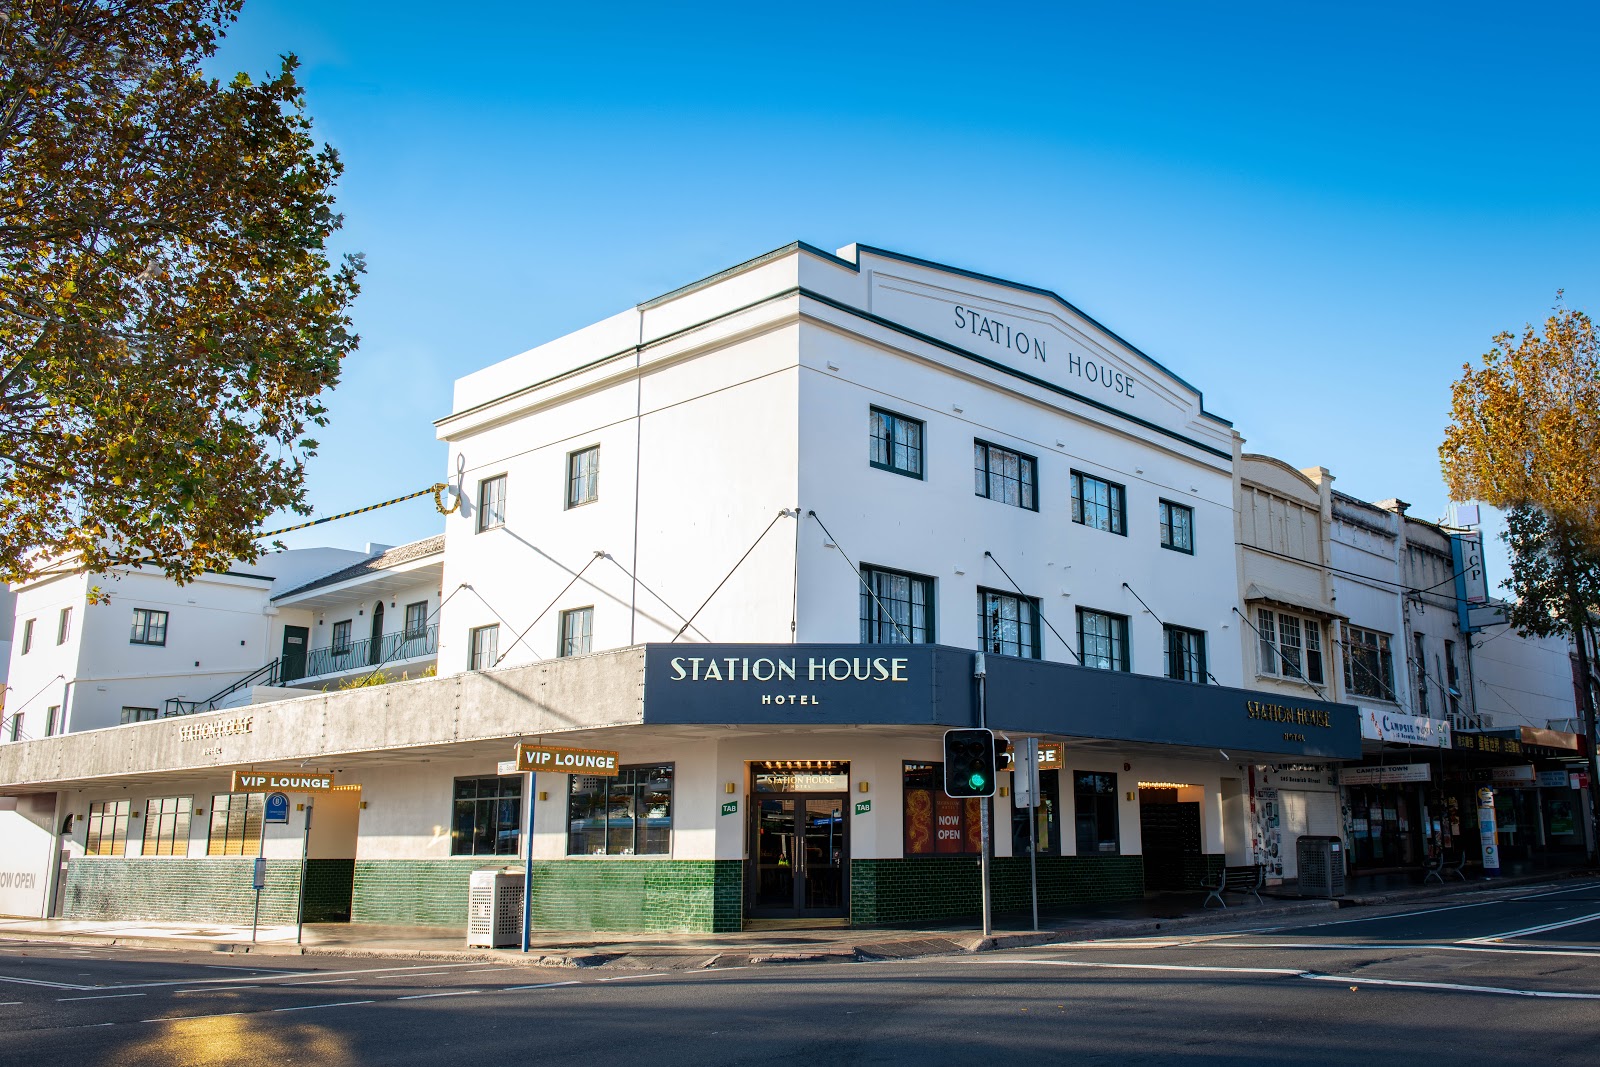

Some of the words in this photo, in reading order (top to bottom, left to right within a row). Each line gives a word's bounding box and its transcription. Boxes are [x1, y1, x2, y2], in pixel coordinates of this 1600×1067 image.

[954, 305, 1046, 363] STATION
[1068, 352, 1135, 399] HOUSE
[670, 657, 796, 681] STATION
[808, 657, 908, 682] HOUSE
[761, 694, 819, 705] HOTEL
[1246, 700, 1294, 723] STATION
[1296, 707, 1332, 728] HOUSE
[178, 722, 216, 742] STATION
[216, 716, 253, 738] HOUSE
[1283, 732, 1306, 742] HOTEL
[526, 751, 551, 765] VIP
[555, 753, 615, 769] LOUNGE
[241, 776, 266, 787] VIP
[270, 777, 330, 789] LOUNGE
[767, 776, 804, 784] STATION
[806, 776, 835, 784] HOUSE
[723, 804, 736, 814] TAB
[857, 803, 870, 812] TAB
[938, 815, 959, 826] NOW
[937, 829, 961, 840] OPEN
[0, 872, 14, 888] OW
[15, 872, 36, 889] OPEN
